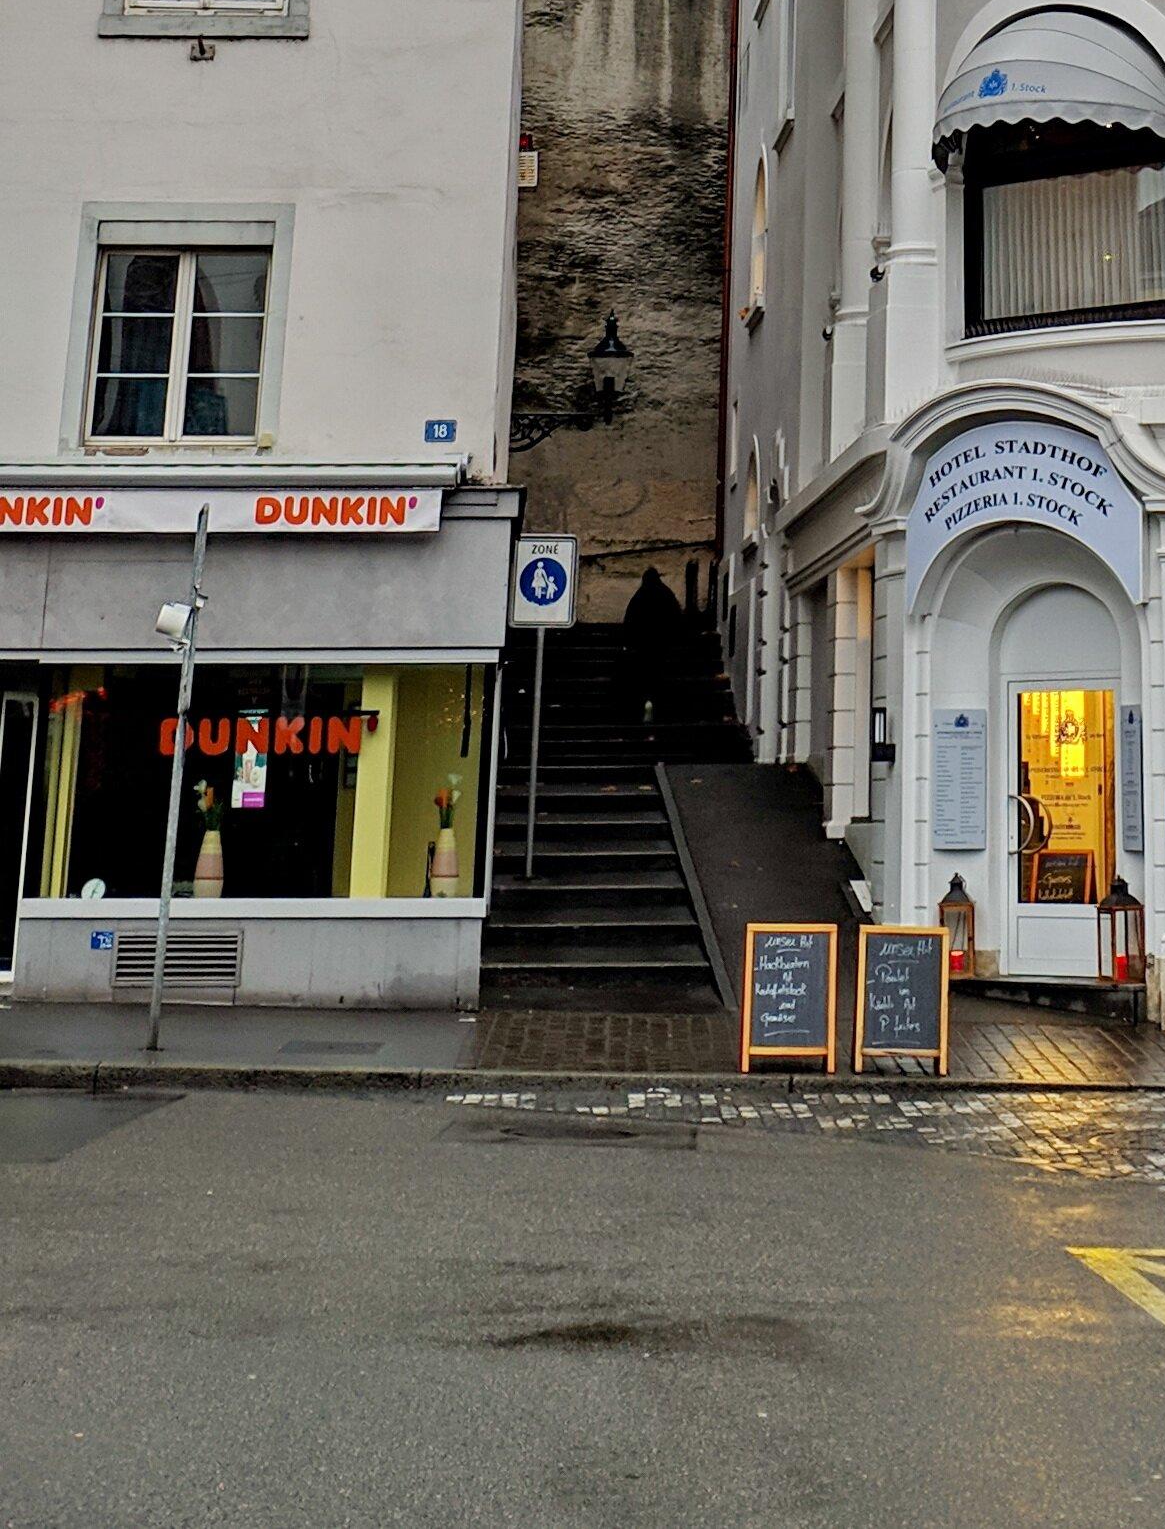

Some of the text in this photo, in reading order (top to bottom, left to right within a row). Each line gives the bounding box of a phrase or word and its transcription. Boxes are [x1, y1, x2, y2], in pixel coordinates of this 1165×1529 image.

[1019, 83, 1047, 94] Stock
[432, 423, 448, 439] 18
[929, 440, 1107, 488] HOTEL STADTHOF
[924, 466, 1114, 523] RESTAURANT 1. STOCK
[255, 496, 417, 526] DUNKIN'
[944, 492, 1084, 531] PIZZERIA 1. STOCK
[531, 544, 560, 555] ZONE
